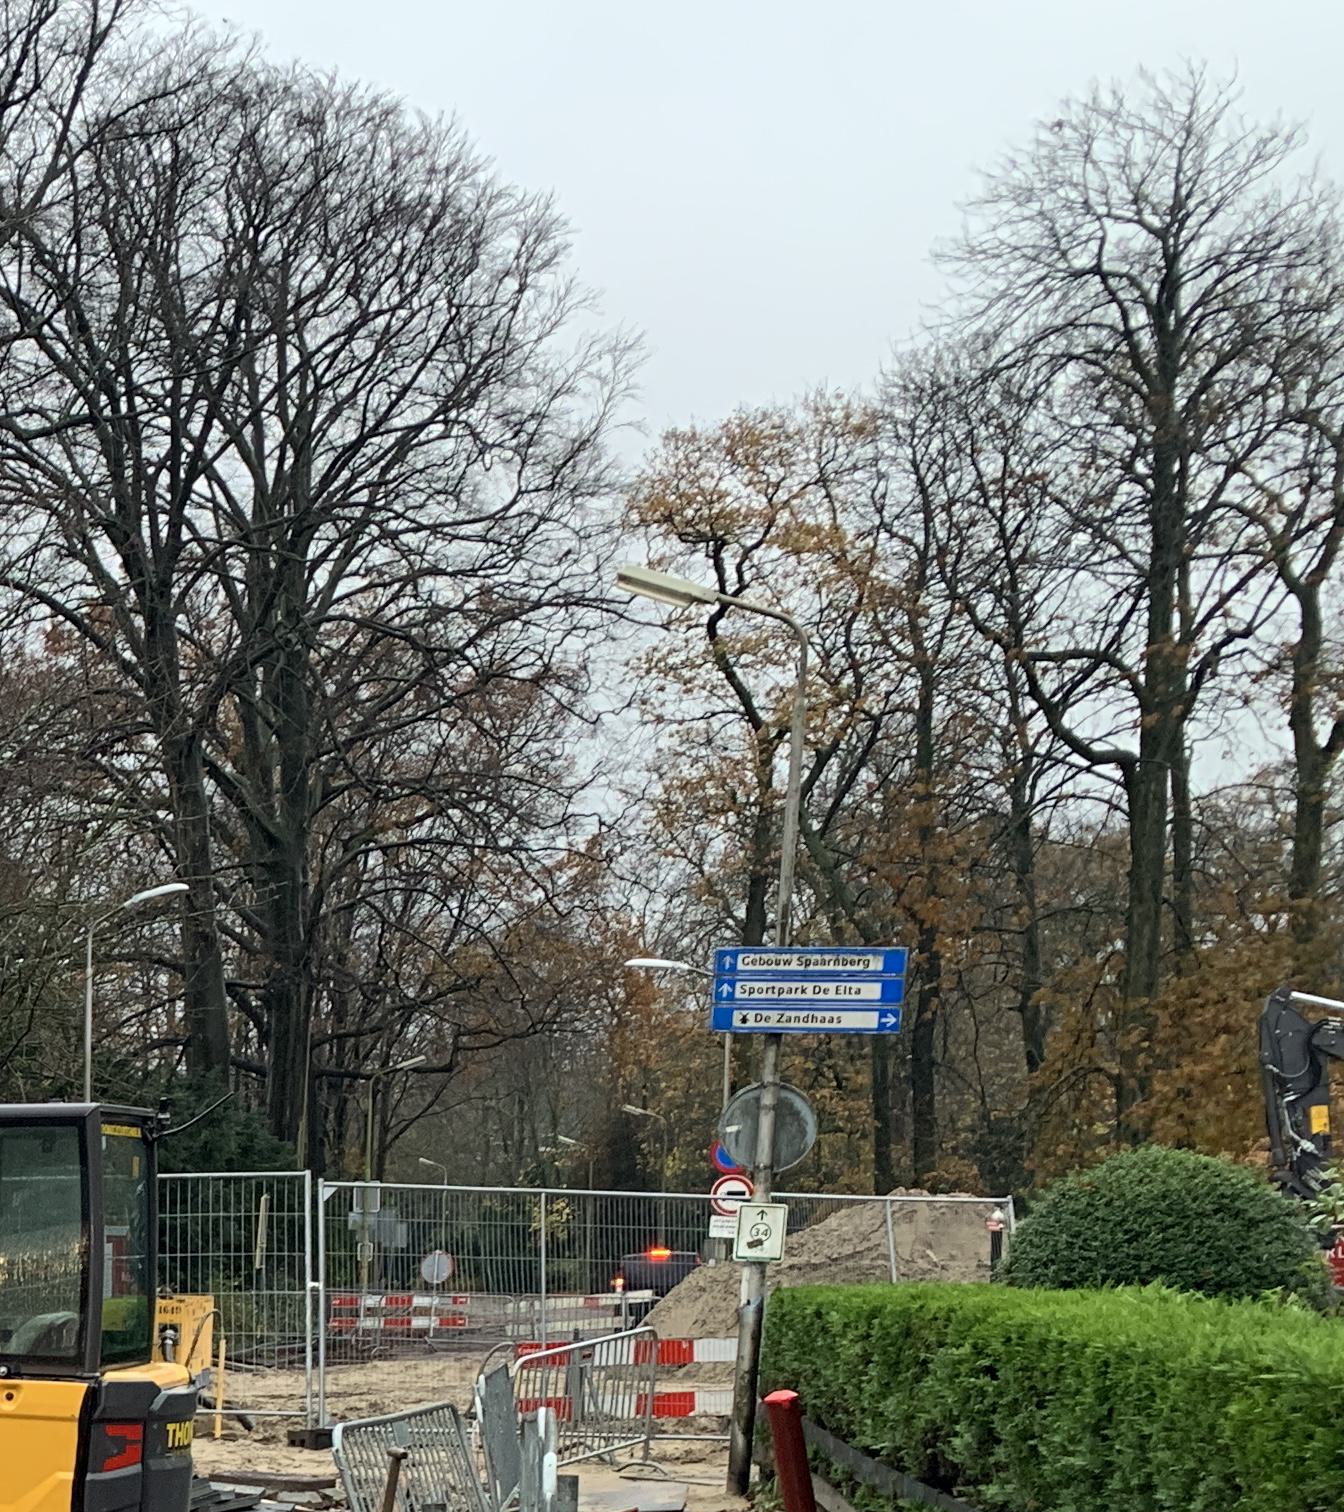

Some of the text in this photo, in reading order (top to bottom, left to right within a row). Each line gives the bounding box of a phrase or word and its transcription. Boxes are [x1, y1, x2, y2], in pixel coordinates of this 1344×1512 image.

[742, 955, 870, 969] Gebouw Spaarnberg
[739, 984, 808, 997] Sportpark
[812, 985, 830, 995] De
[754, 1013, 842, 1025] De Zandhaas
[753, 1227, 769, 1237] 34
